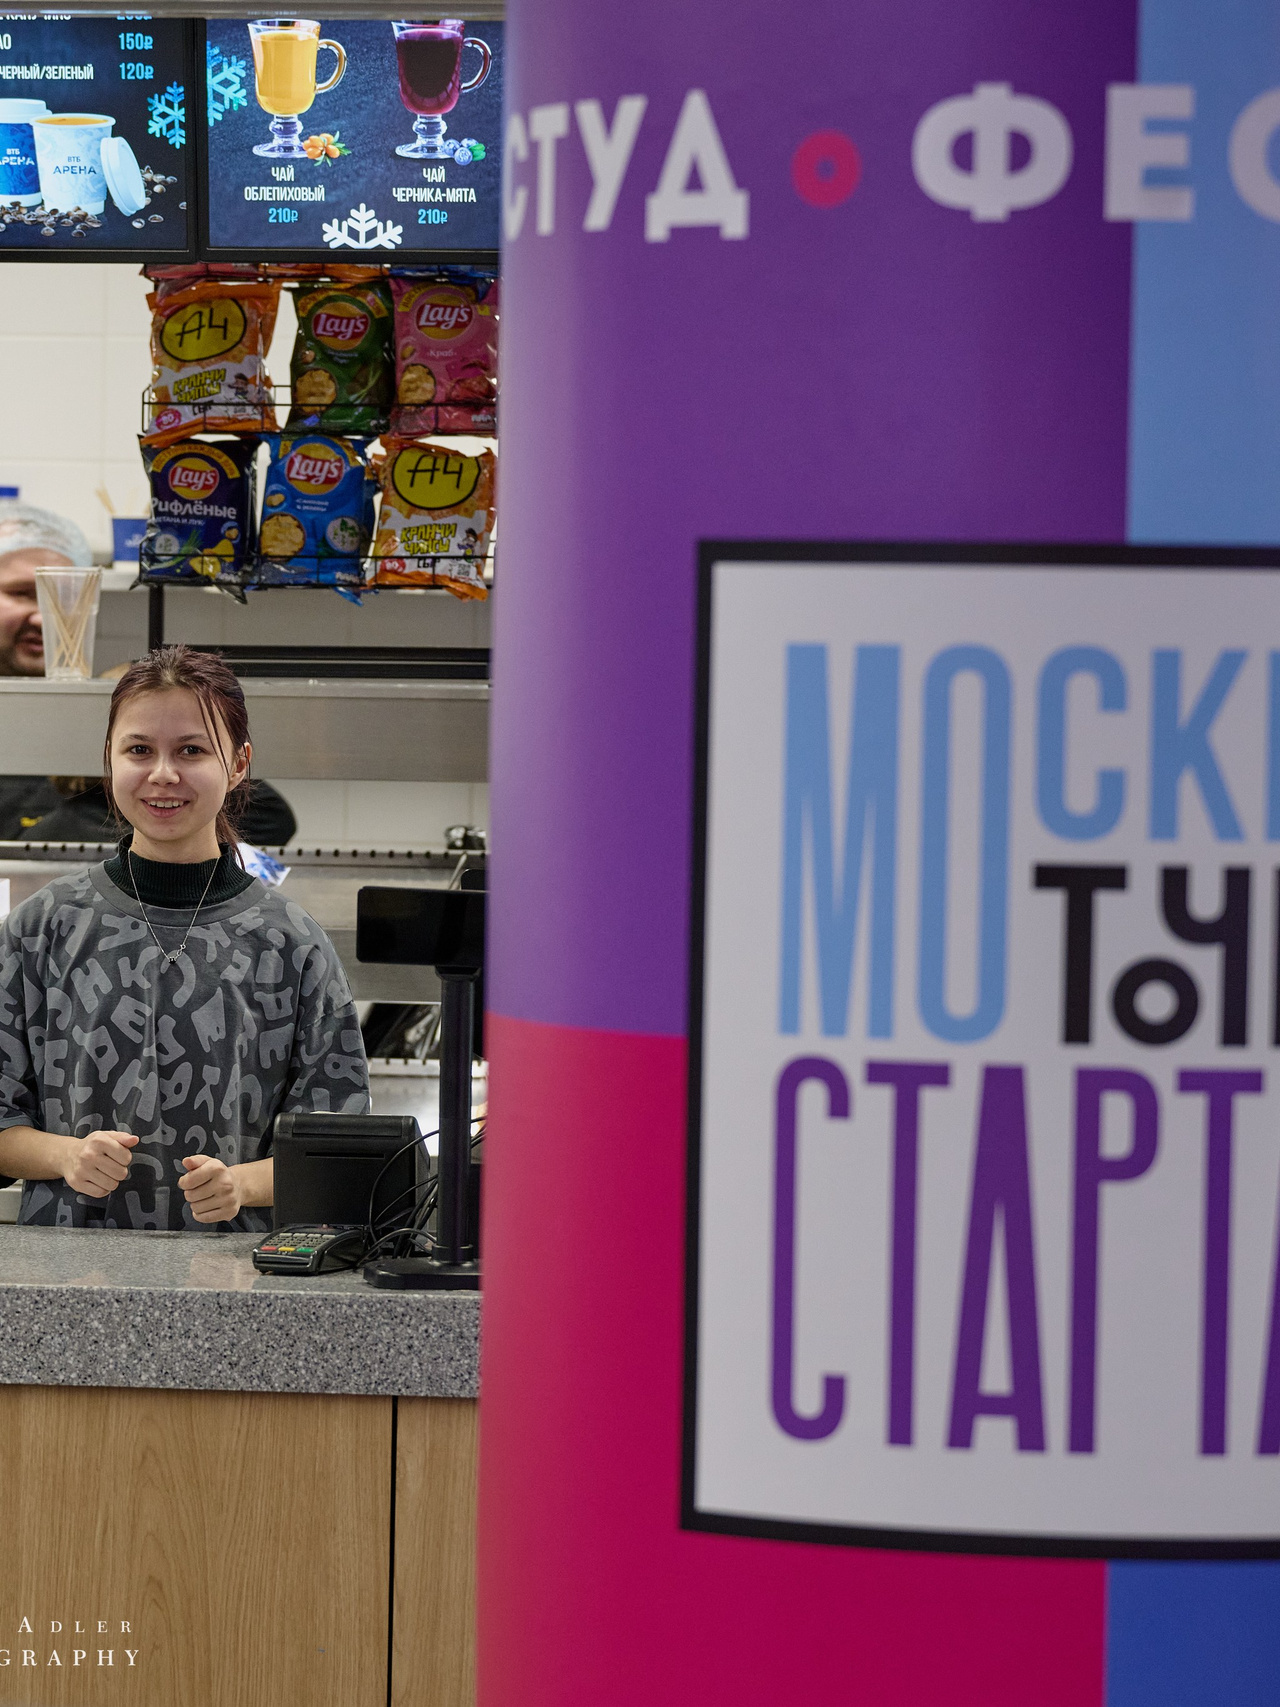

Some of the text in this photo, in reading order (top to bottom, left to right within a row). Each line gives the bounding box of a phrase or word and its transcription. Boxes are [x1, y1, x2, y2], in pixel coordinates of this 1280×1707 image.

[53, 166, 97, 175] АРЕНА
[271, 165, 295, 182] ЧАЙ
[422, 166, 446, 183] ЧАЙ
[244, 185, 325, 201] ОБЛЕПИХОВЫЙ
[392, 187, 477, 203] ЧЕРНИКА-МЯТА
[316, 313, 367, 340] Lay's
[419, 304, 471, 330] Lay's
[172, 466, 216, 491] Lay's
[289, 454, 341, 485] Lay's
[400, 523, 457, 543] КРАНЧИ
[776, 641, 1280, 1044] МОСК
[1032, 863, 1280, 1048] ТОЧ
